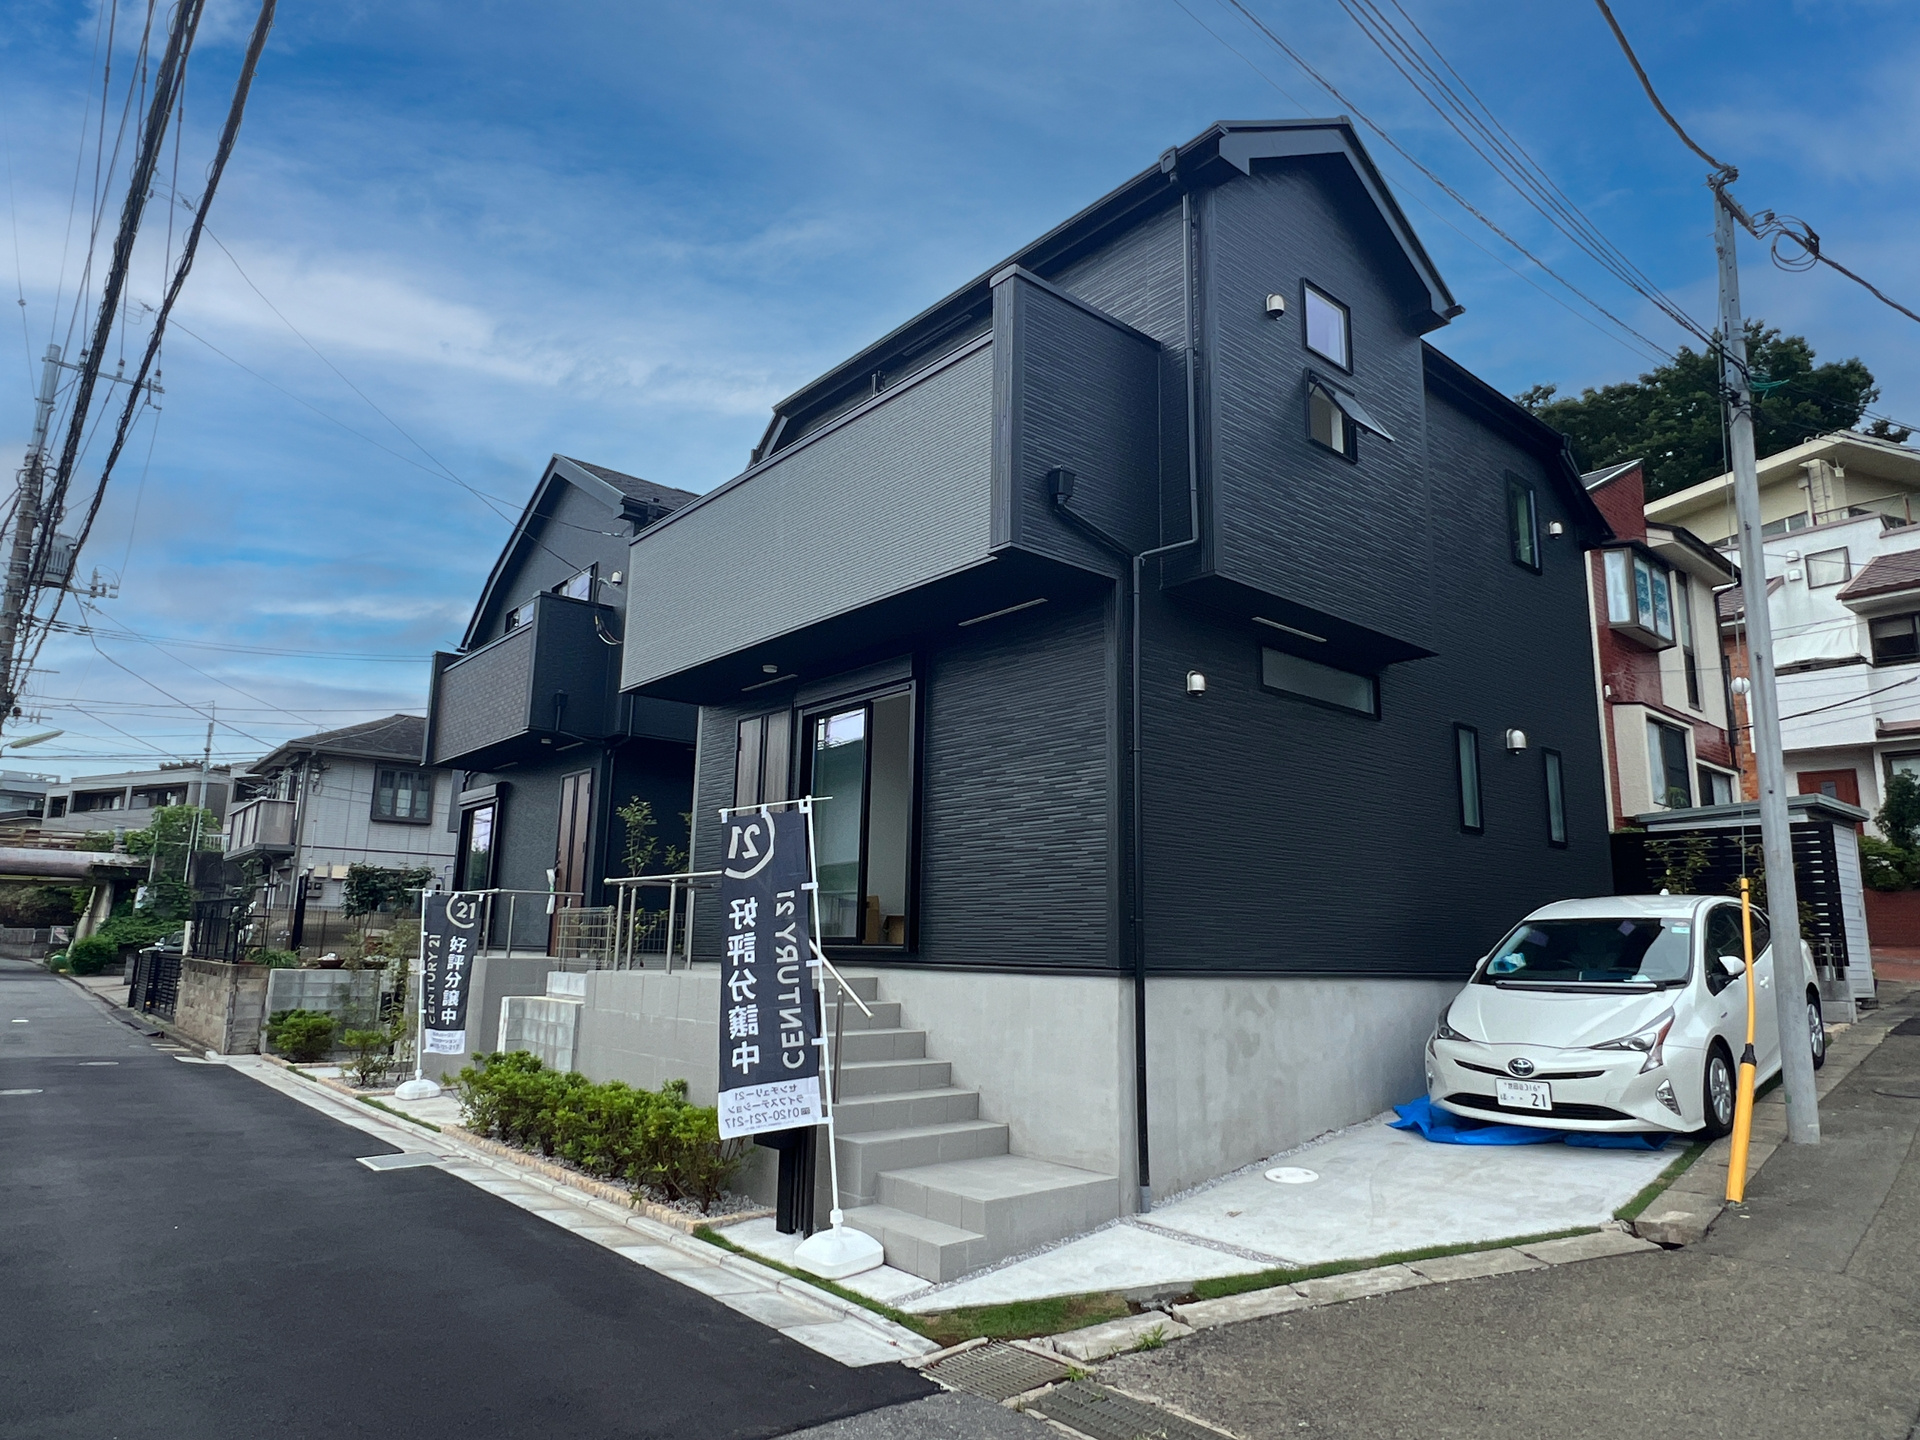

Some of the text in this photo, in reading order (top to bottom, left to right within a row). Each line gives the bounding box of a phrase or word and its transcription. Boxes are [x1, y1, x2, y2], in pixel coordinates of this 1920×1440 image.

[456, 901, 476, 919] 21
[428, 954, 438, 1025] CENTURY
[441, 935, 467, 1025] 好評分譲中
